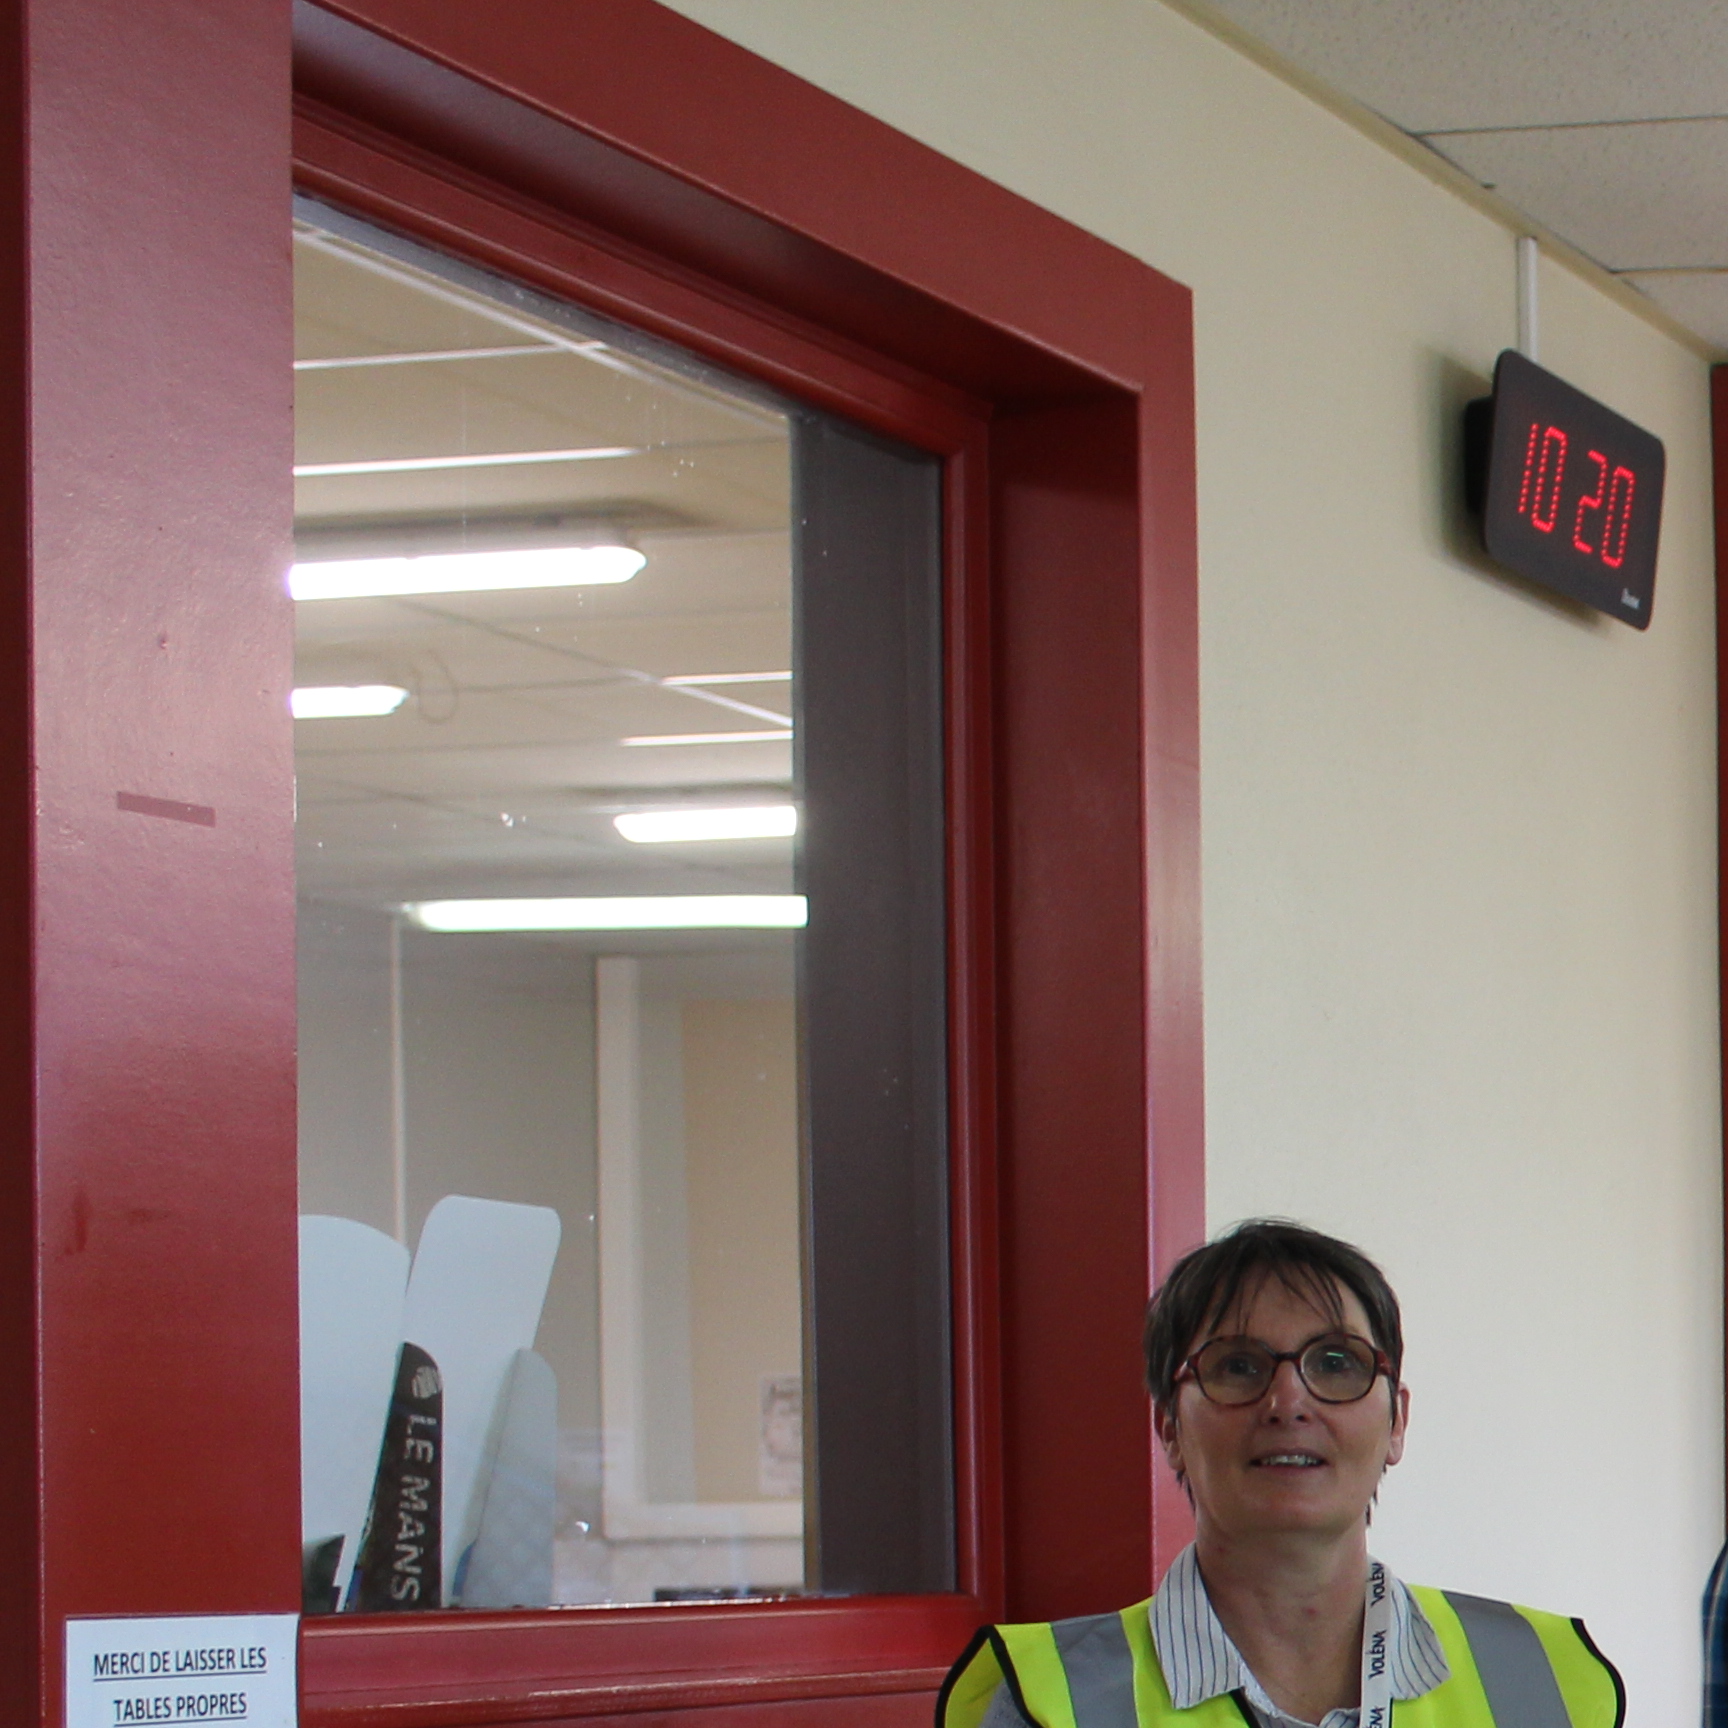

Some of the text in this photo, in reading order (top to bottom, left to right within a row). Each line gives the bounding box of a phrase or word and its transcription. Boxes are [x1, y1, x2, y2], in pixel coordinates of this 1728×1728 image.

[1518, 423, 1636, 568] 10 20
[389, 1413, 437, 1601] LE MANS
[93, 1646, 267, 1676] MERCI DE LAISSER LES
[113, 1692, 247, 1721] TABLES PROPRES
